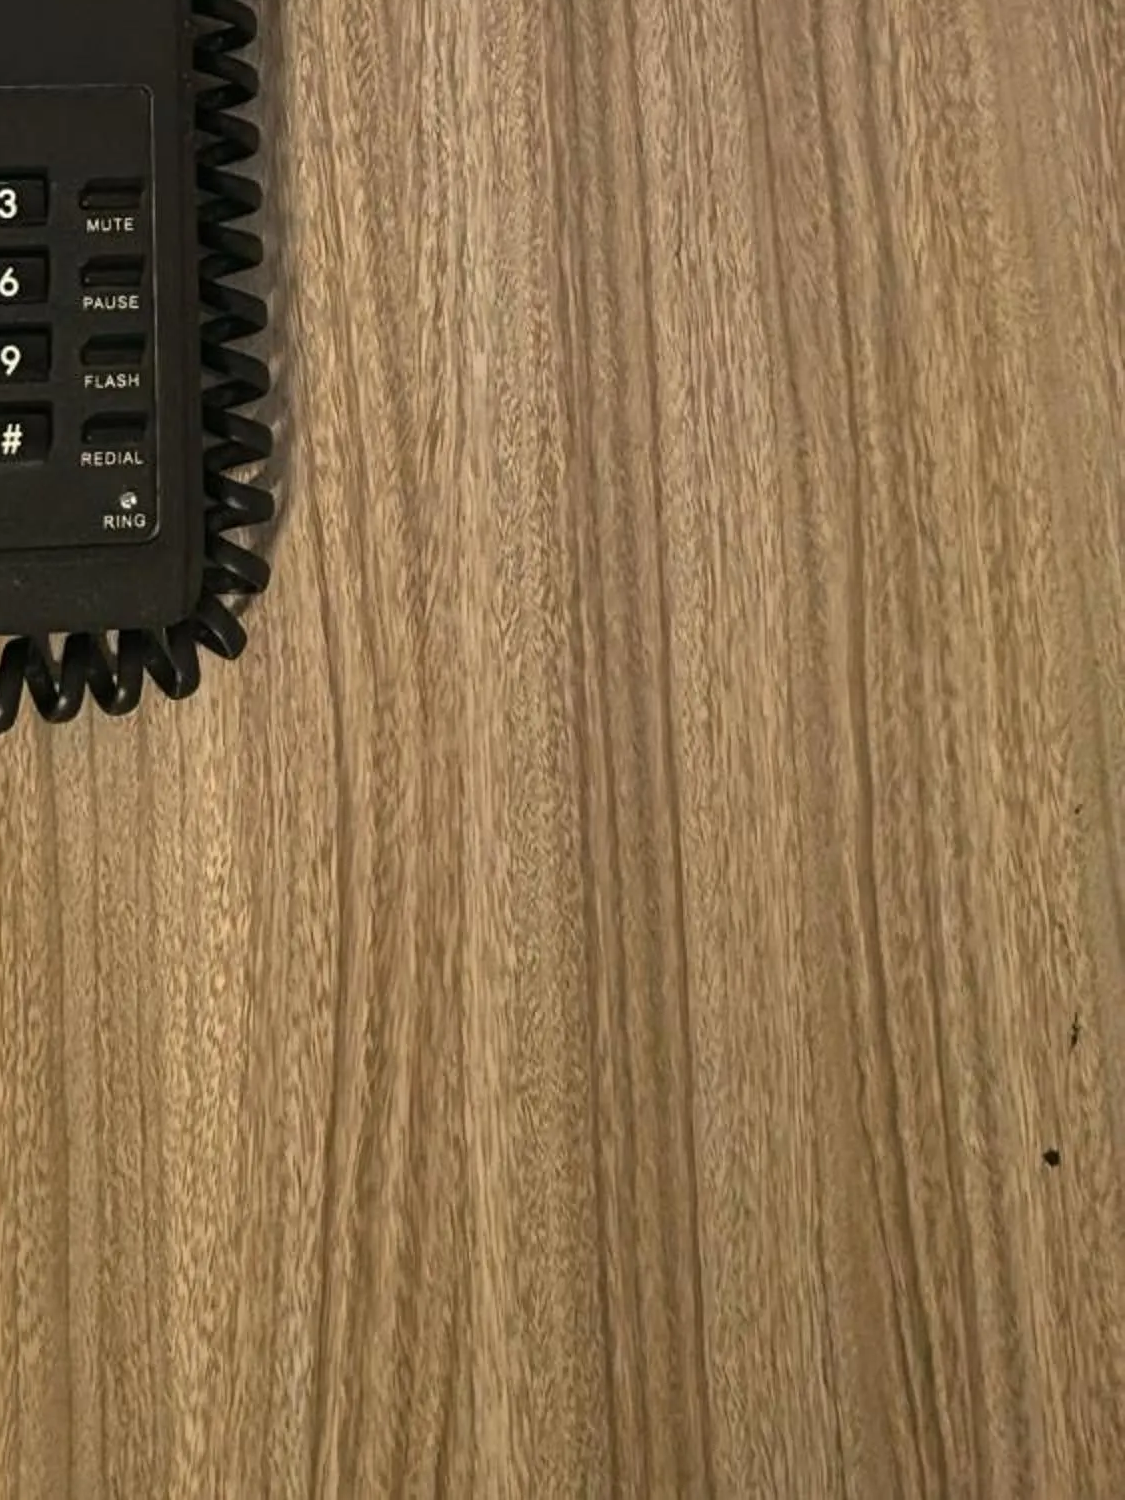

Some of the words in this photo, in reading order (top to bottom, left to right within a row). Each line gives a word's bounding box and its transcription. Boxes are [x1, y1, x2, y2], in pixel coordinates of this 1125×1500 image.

[86, 216, 134, 232] MUTE
[82, 294, 140, 310] PAUSE
[0, 345, 21, 376] 9
[84, 373, 140, 389] FLASH
[80, 451, 144, 467] REDIAL
[103, 513, 146, 529] RING
